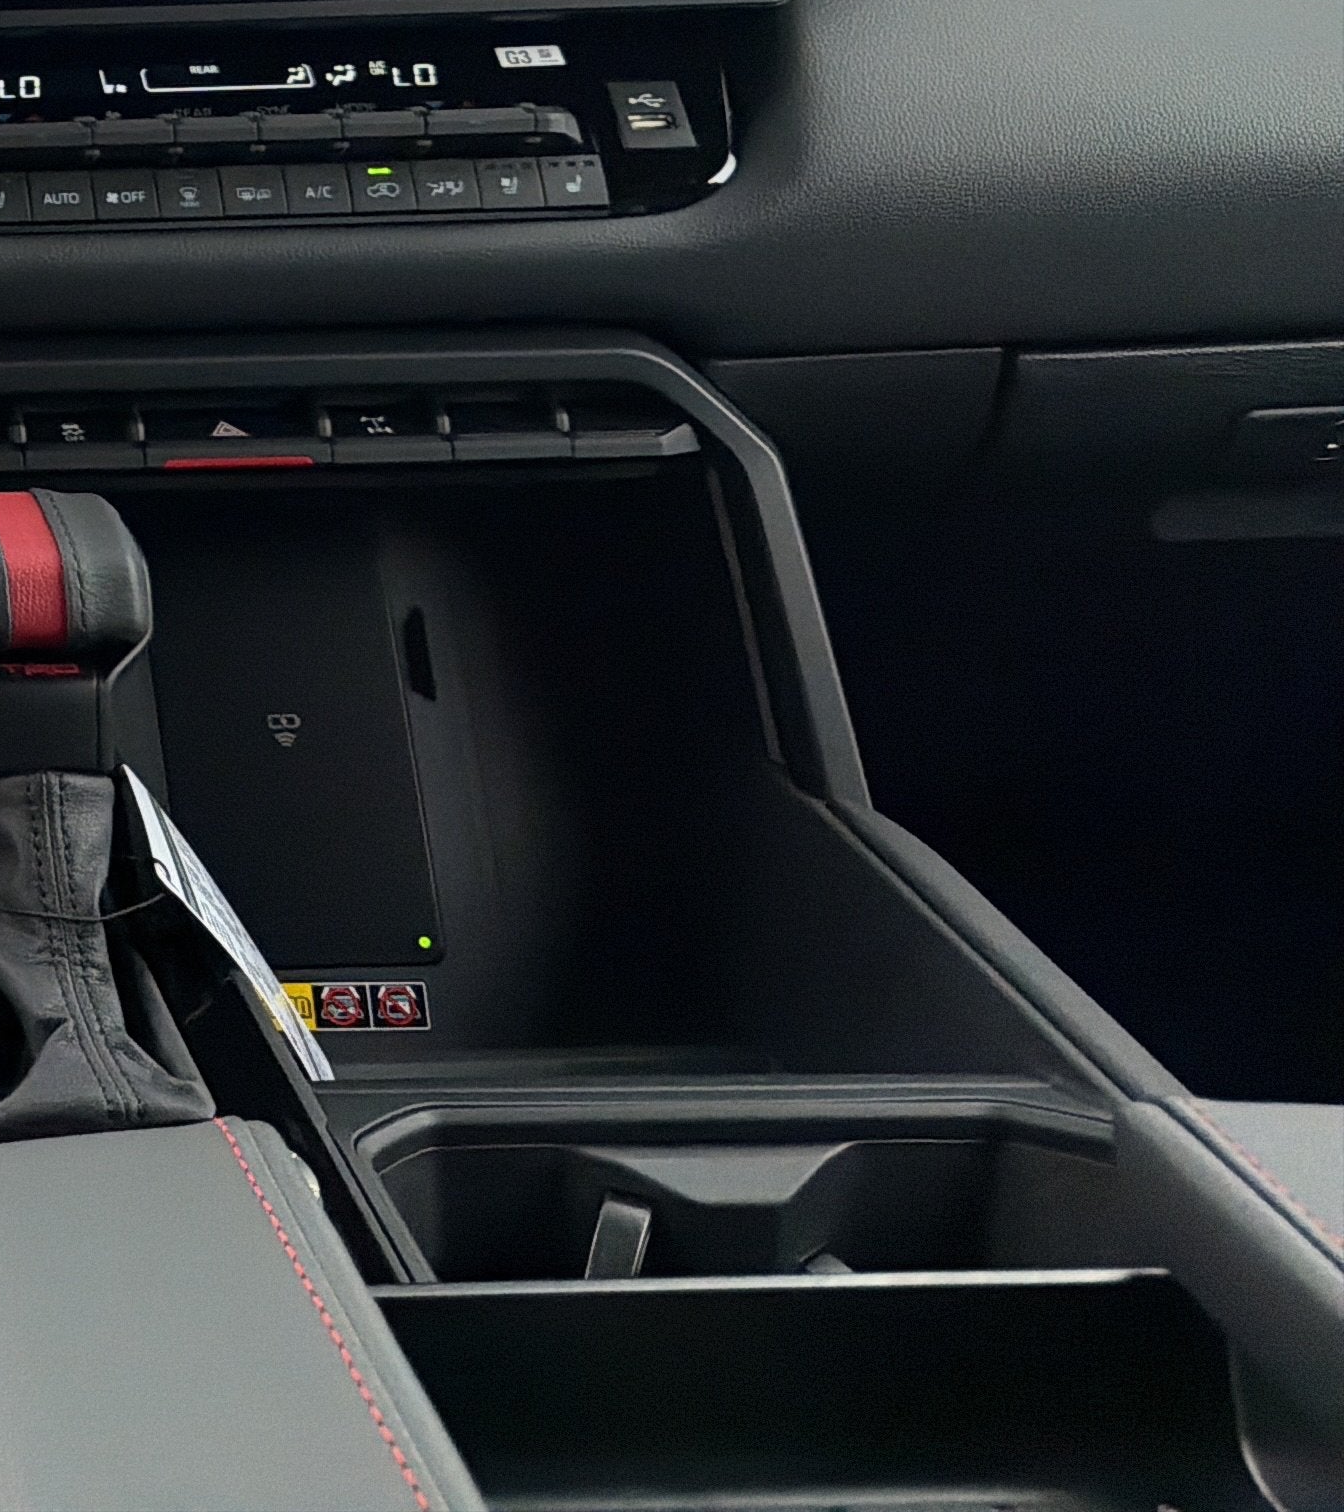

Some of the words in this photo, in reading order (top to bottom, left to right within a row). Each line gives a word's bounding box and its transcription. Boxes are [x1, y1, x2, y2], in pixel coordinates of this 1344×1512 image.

[504, 49, 532, 66] G3
[392, 62, 438, 87] LO
[42, 192, 80, 205] AUTO
[120, 191, 146, 203] OFF
[304, 186, 333, 199] A/C
